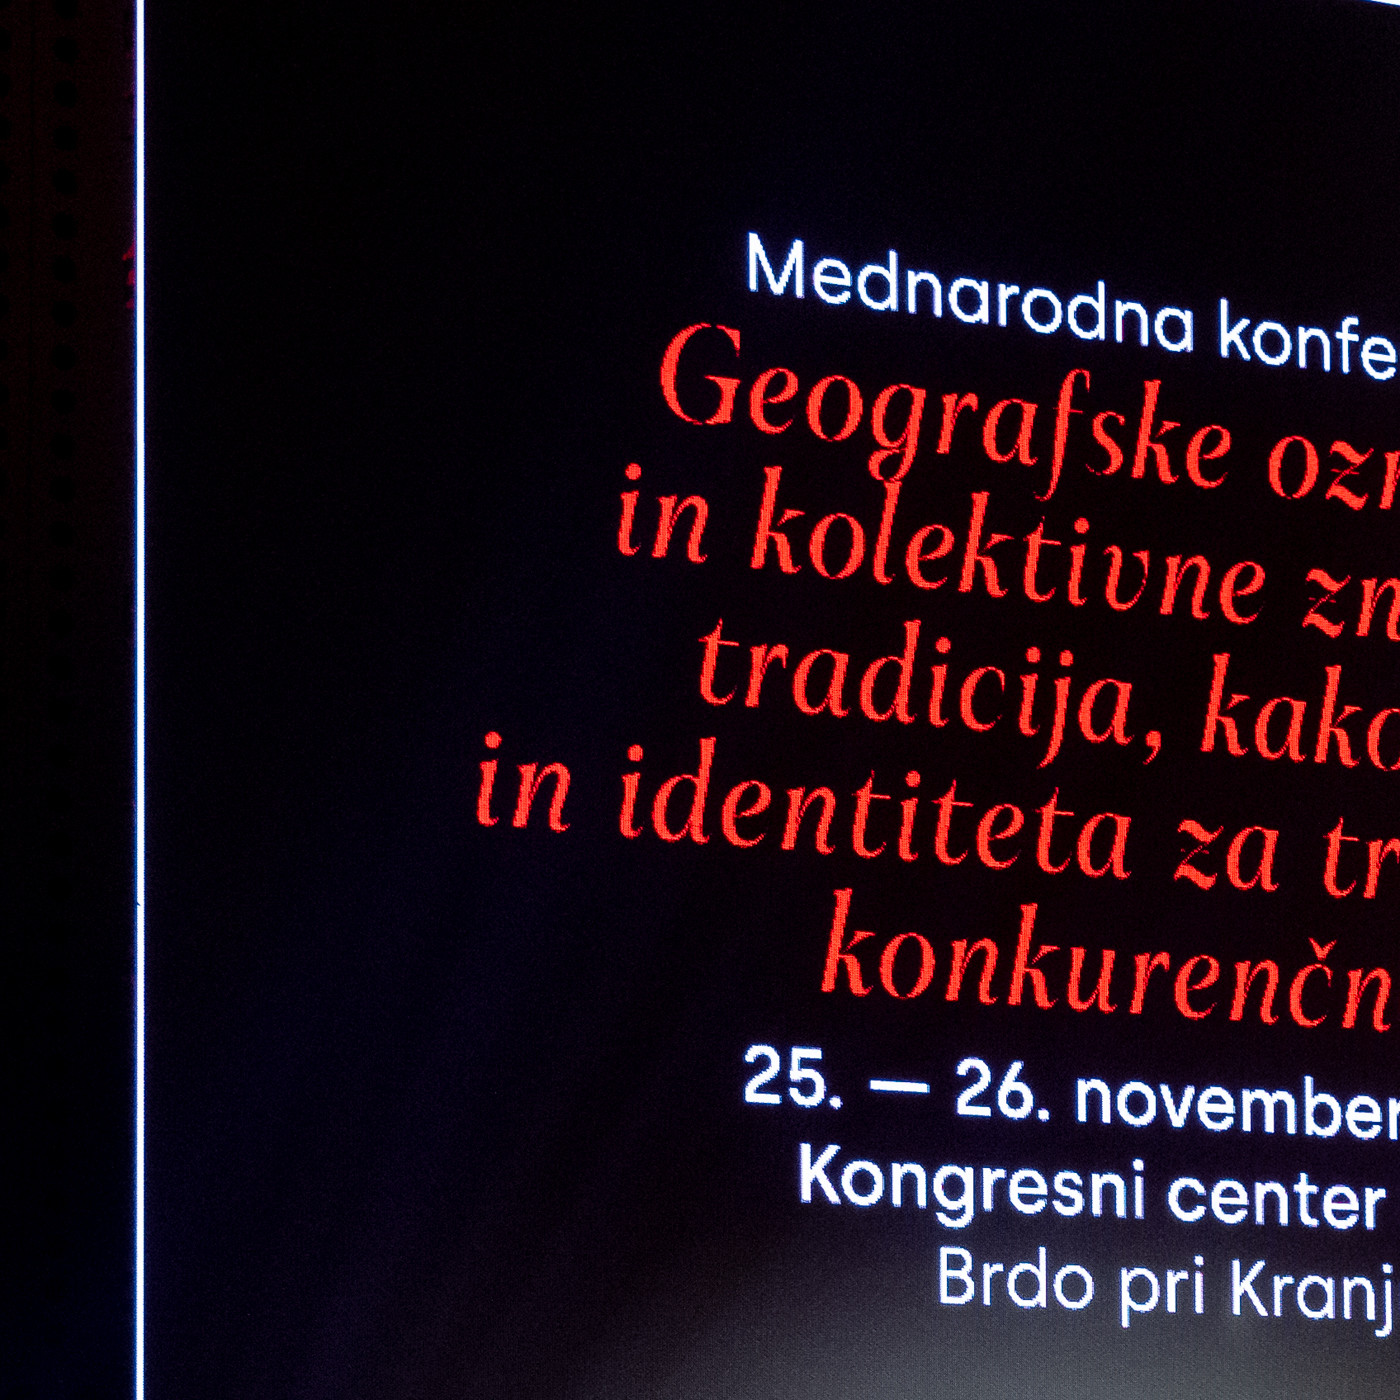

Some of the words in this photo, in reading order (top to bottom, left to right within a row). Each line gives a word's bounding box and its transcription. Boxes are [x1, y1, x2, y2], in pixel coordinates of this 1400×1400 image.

[745, 230, 1195, 354] Mednarodna
[659, 316, 1232, 502] Geografske
[616, 461, 710, 565] in
[749, 464, 1267, 626] kolektivne
[697, 617, 1163, 769] tradicija,
[475, 730, 572, 835] in
[618, 735, 1133, 882] identiteta
[1172, 818, 1281, 894] za
[743, 1042, 845, 1112] 25.
[954, 1055, 1051, 1124] 26.
[798, 1141, 1146, 1232] Kongresni
[1166, 1171, 1388, 1232] center
[937, 1243, 1096, 1312] Brdo
[1117, 1253, 1206, 1330] pri
